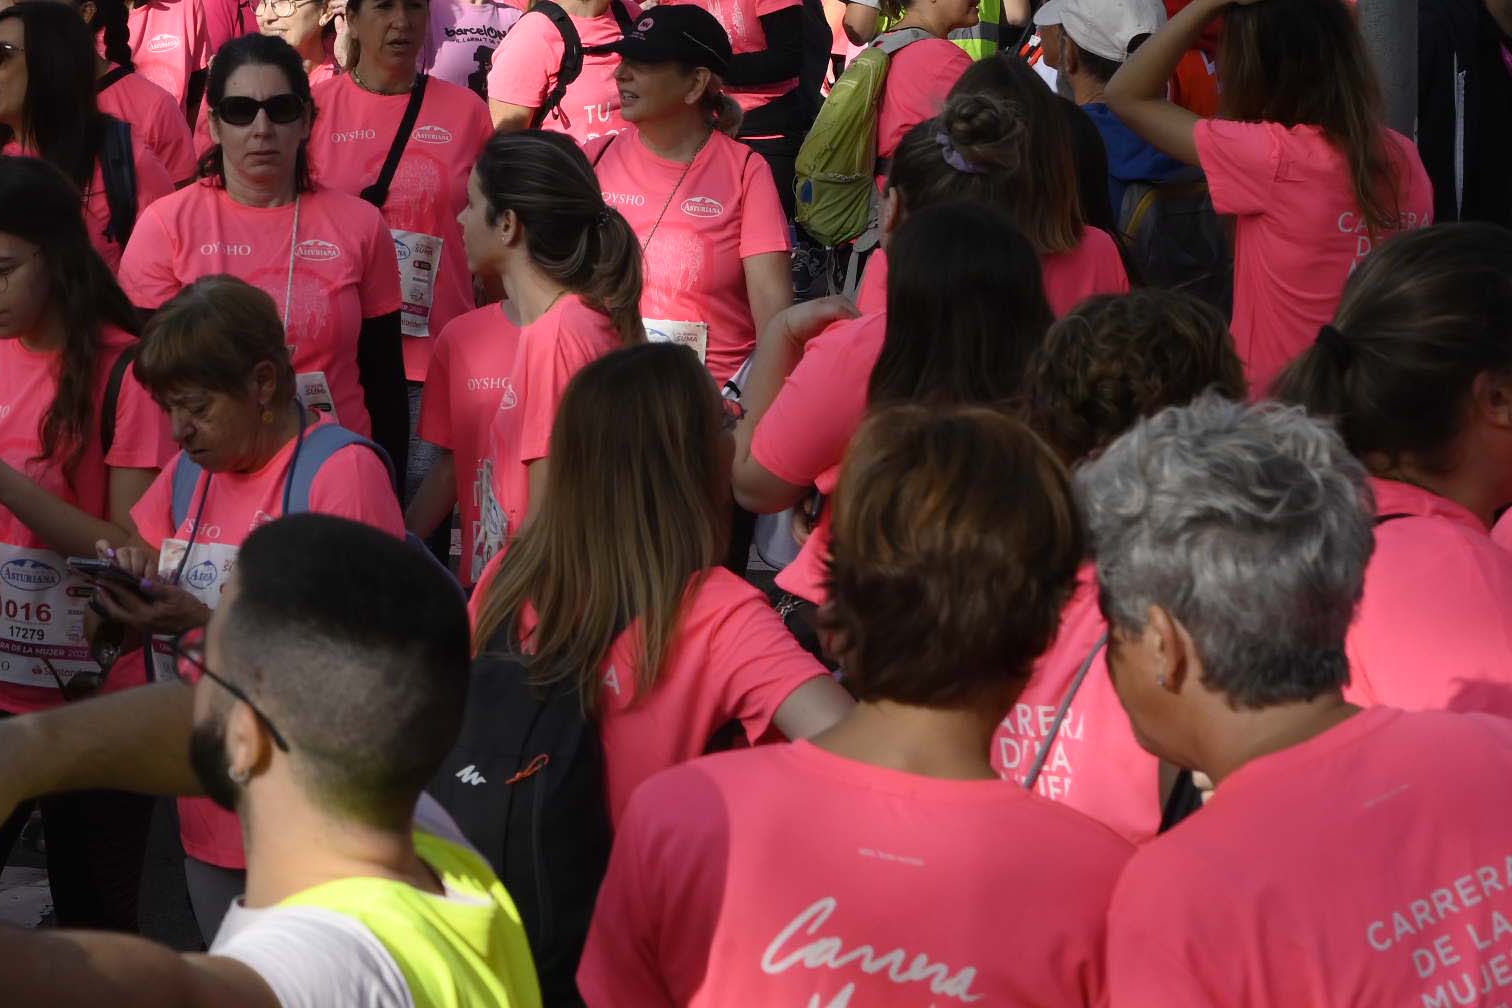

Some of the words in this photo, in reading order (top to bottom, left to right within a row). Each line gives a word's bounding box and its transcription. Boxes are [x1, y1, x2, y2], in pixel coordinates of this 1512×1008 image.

[584, 103, 611, 124] TU
[331, 129, 376, 143] OYSHO
[601, 192, 646, 206] OYSHO
[6, 567, 57, 584] ASTURIANA
[5, 600, 52, 622] 016
[9, 625, 45, 641] 17279
[1412, 935, 1462, 979] DE
